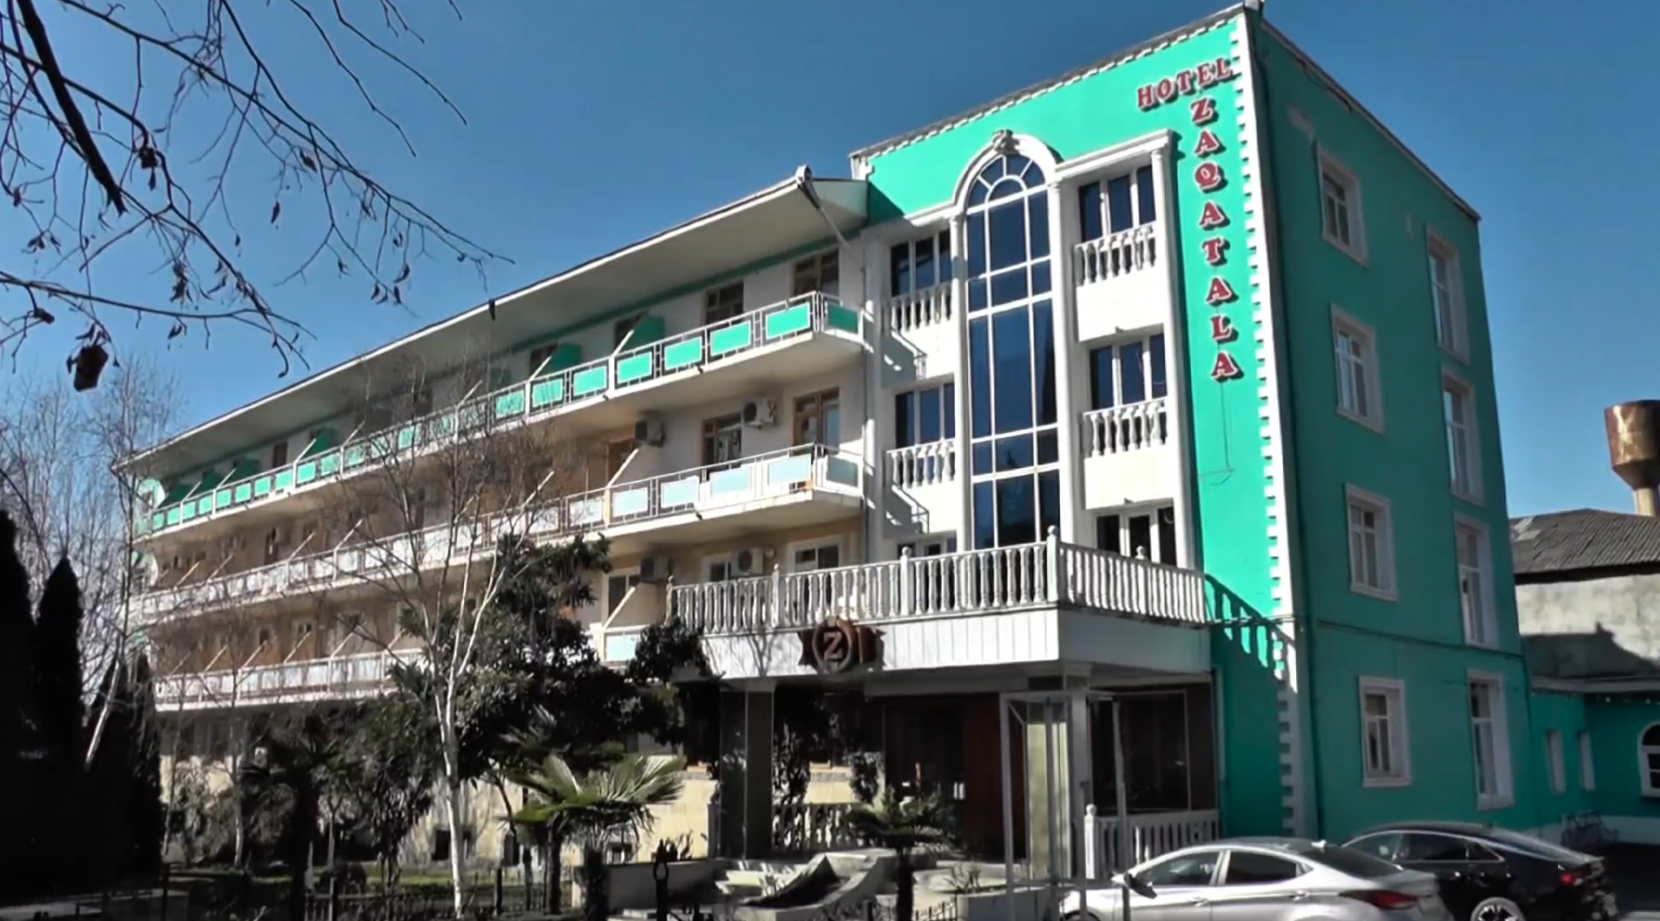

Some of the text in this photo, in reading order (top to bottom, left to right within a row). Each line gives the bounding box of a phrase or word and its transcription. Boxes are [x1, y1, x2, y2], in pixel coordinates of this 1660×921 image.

[1137, 57, 1234, 110] HOTEL
[1190, 97, 1241, 381] ZAQATALA
[823, 632, 843, 660] Z
